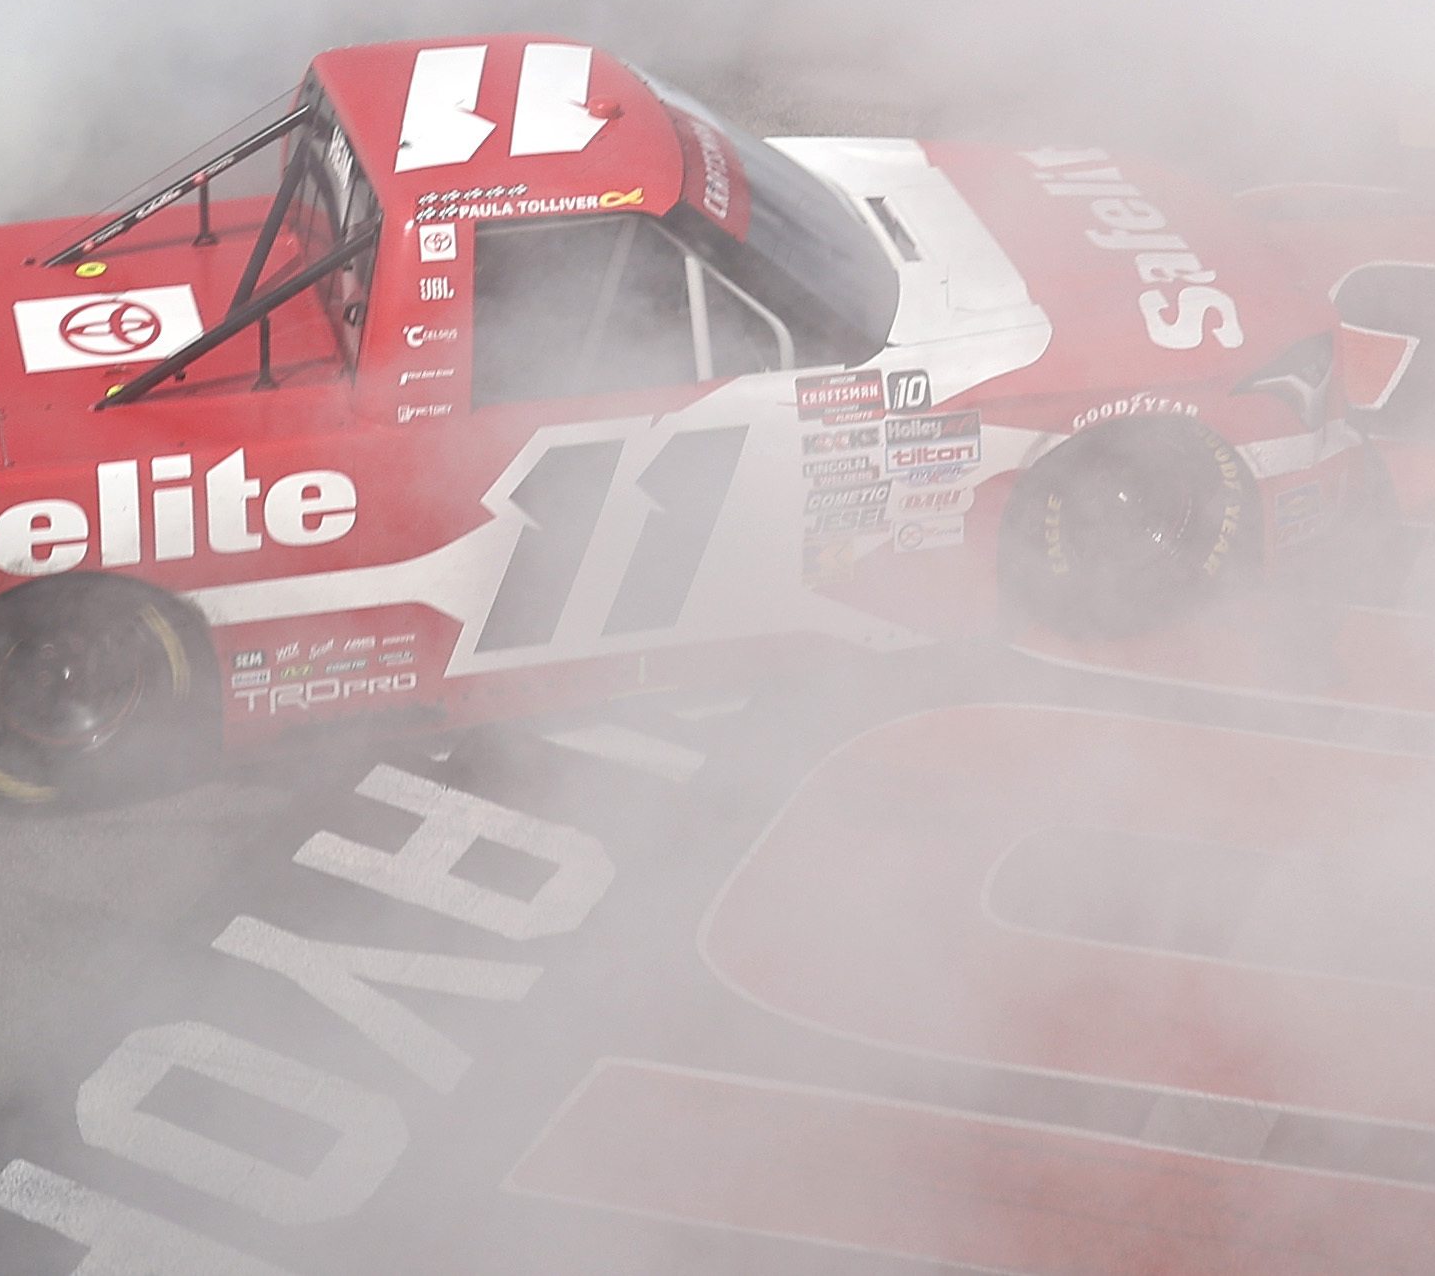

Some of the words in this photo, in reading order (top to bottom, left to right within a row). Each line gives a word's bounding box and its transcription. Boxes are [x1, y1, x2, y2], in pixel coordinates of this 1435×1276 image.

[394, 42, 610, 174] 11
[459, 200, 514, 221] PAULA
[518, 194, 600, 215] TOLLIVER
[1017, 144, 1245, 351] Safelit
[419, 276, 456, 300] JBL
[801, 383, 879, 406] CRAFTSMAN
[892, 374, 928, 410] 10
[1071, 390, 1201, 433] GOODYEAR
[885, 419, 943, 439] Holley
[892, 444, 975, 468] tilton
[804, 506, 889, 536] JESEL
[472, 424, 750, 656] 11
[233, 677, 341, 715] TRD
[343, 671, 418, 700] PRO
